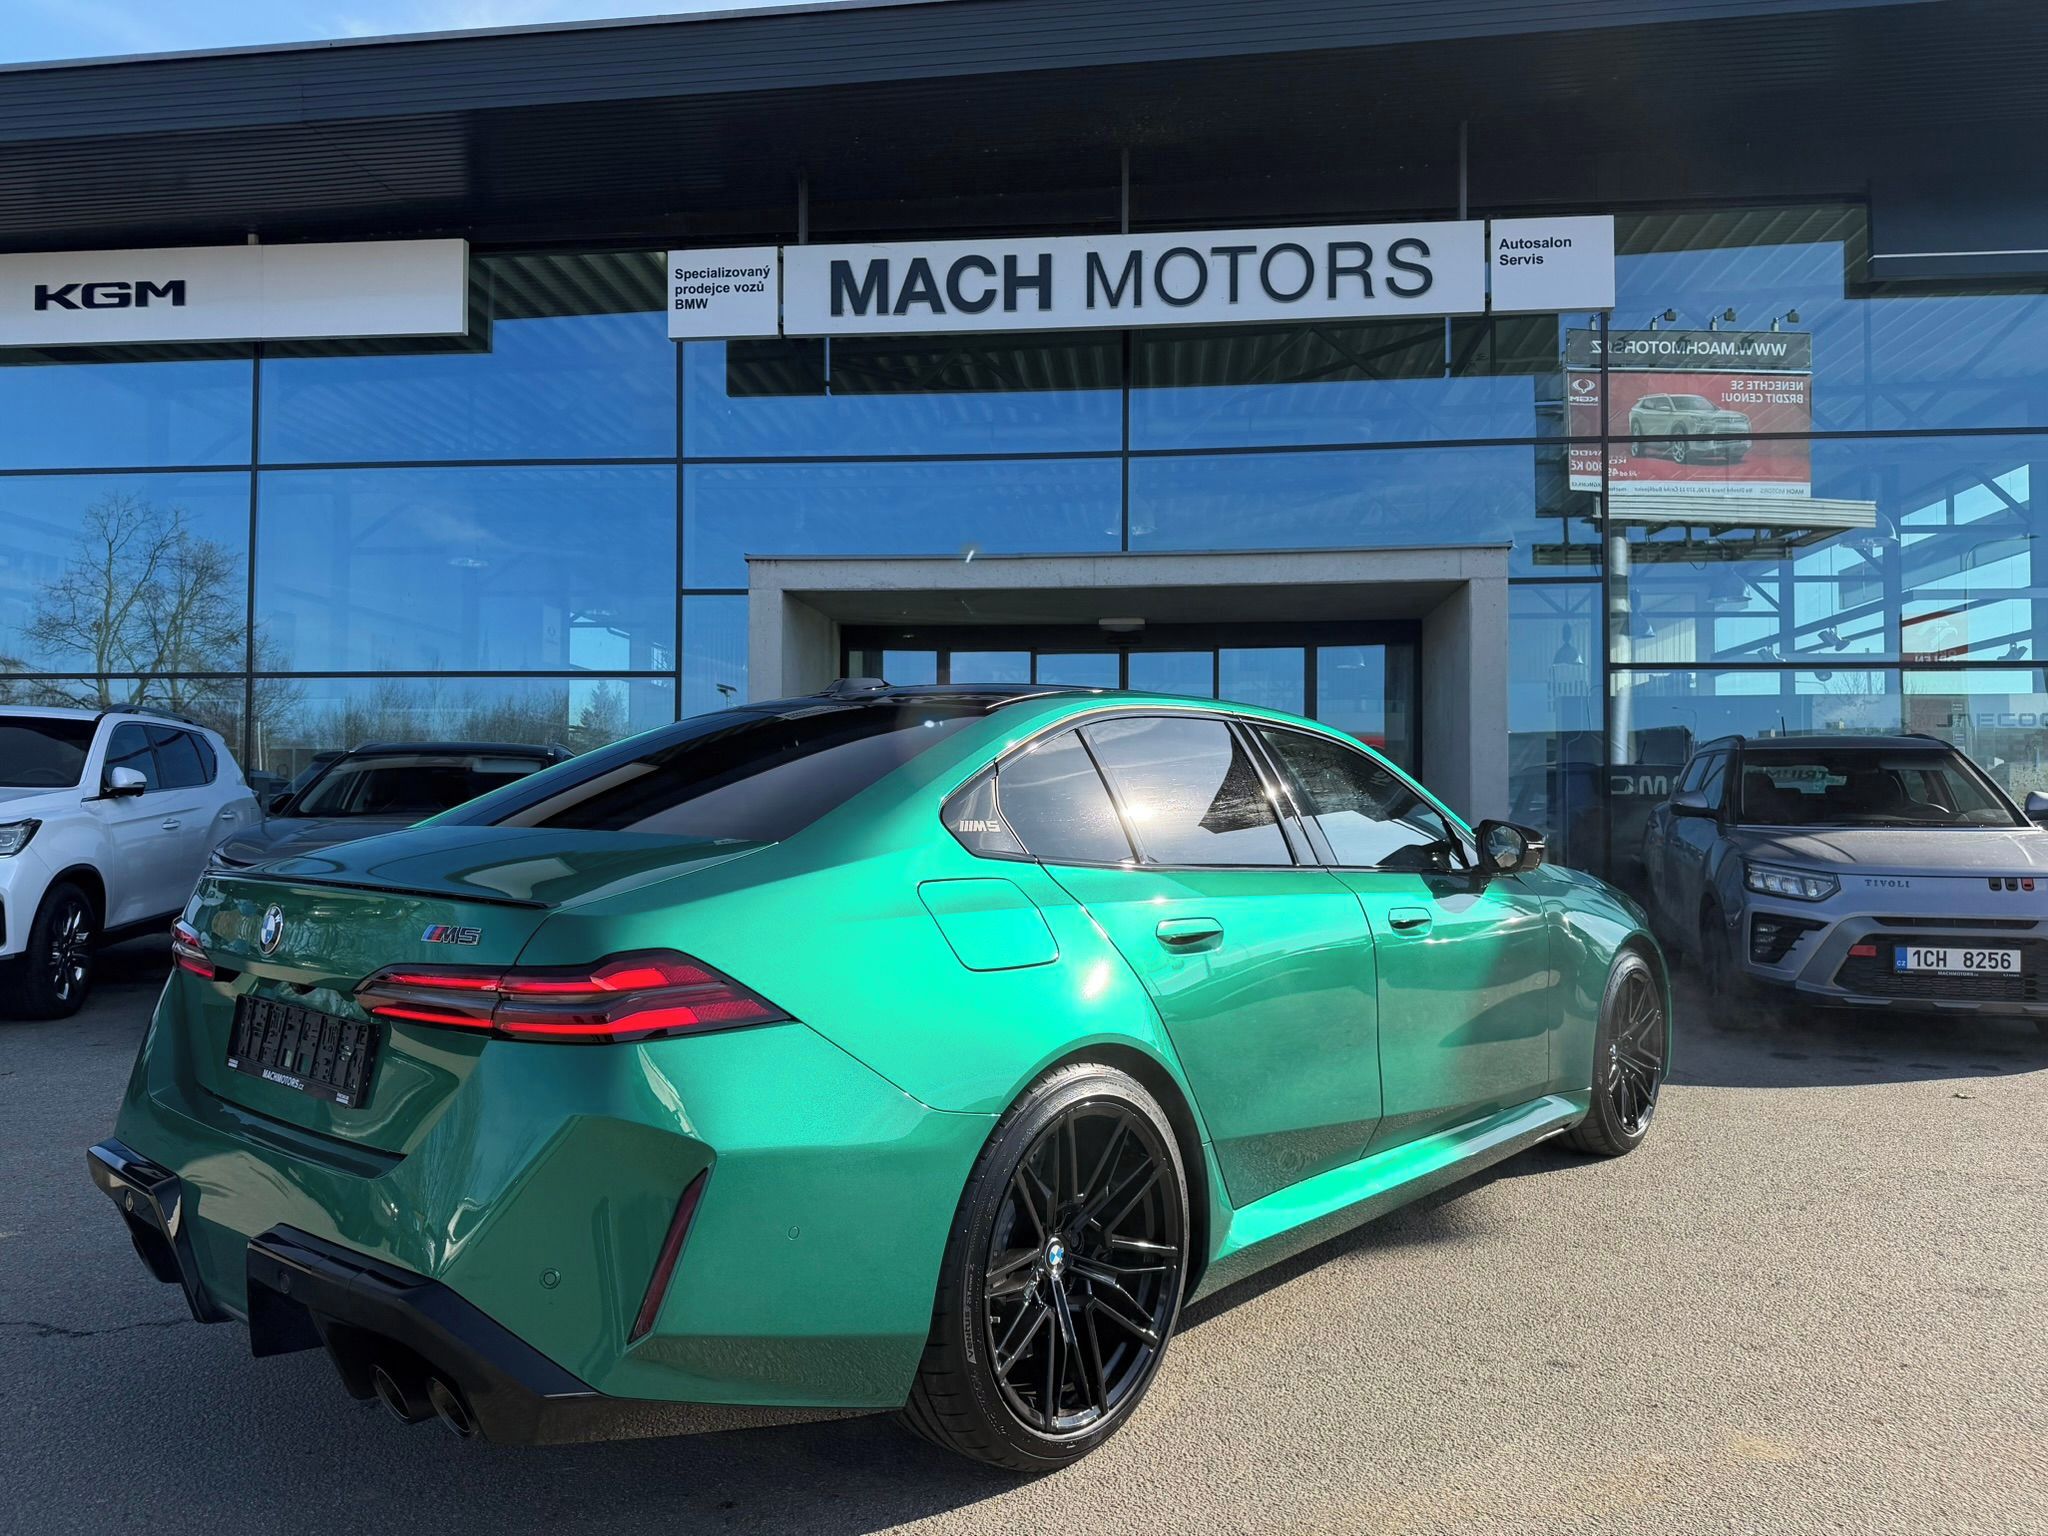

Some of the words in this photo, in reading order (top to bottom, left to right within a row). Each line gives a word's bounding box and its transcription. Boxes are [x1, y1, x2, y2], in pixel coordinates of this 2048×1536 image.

[1499, 236, 1572, 250] Autosalon
[1499, 253, 1544, 266] Servis
[674, 265, 771, 281] Specializovaný
[829, 253, 1053, 317] MACH
[1084, 237, 1434, 310] MOTORS
[34, 280, 186, 311] KGM
[675, 282, 730, 297] prodejce
[734, 281, 764, 293] vozů
[675, 298, 709, 310] BMW
[1864, 879, 1911, 889] TIVOLI
[1912, 950, 1948, 968] 1CH
[1962, 951, 2012, 970] 8256
